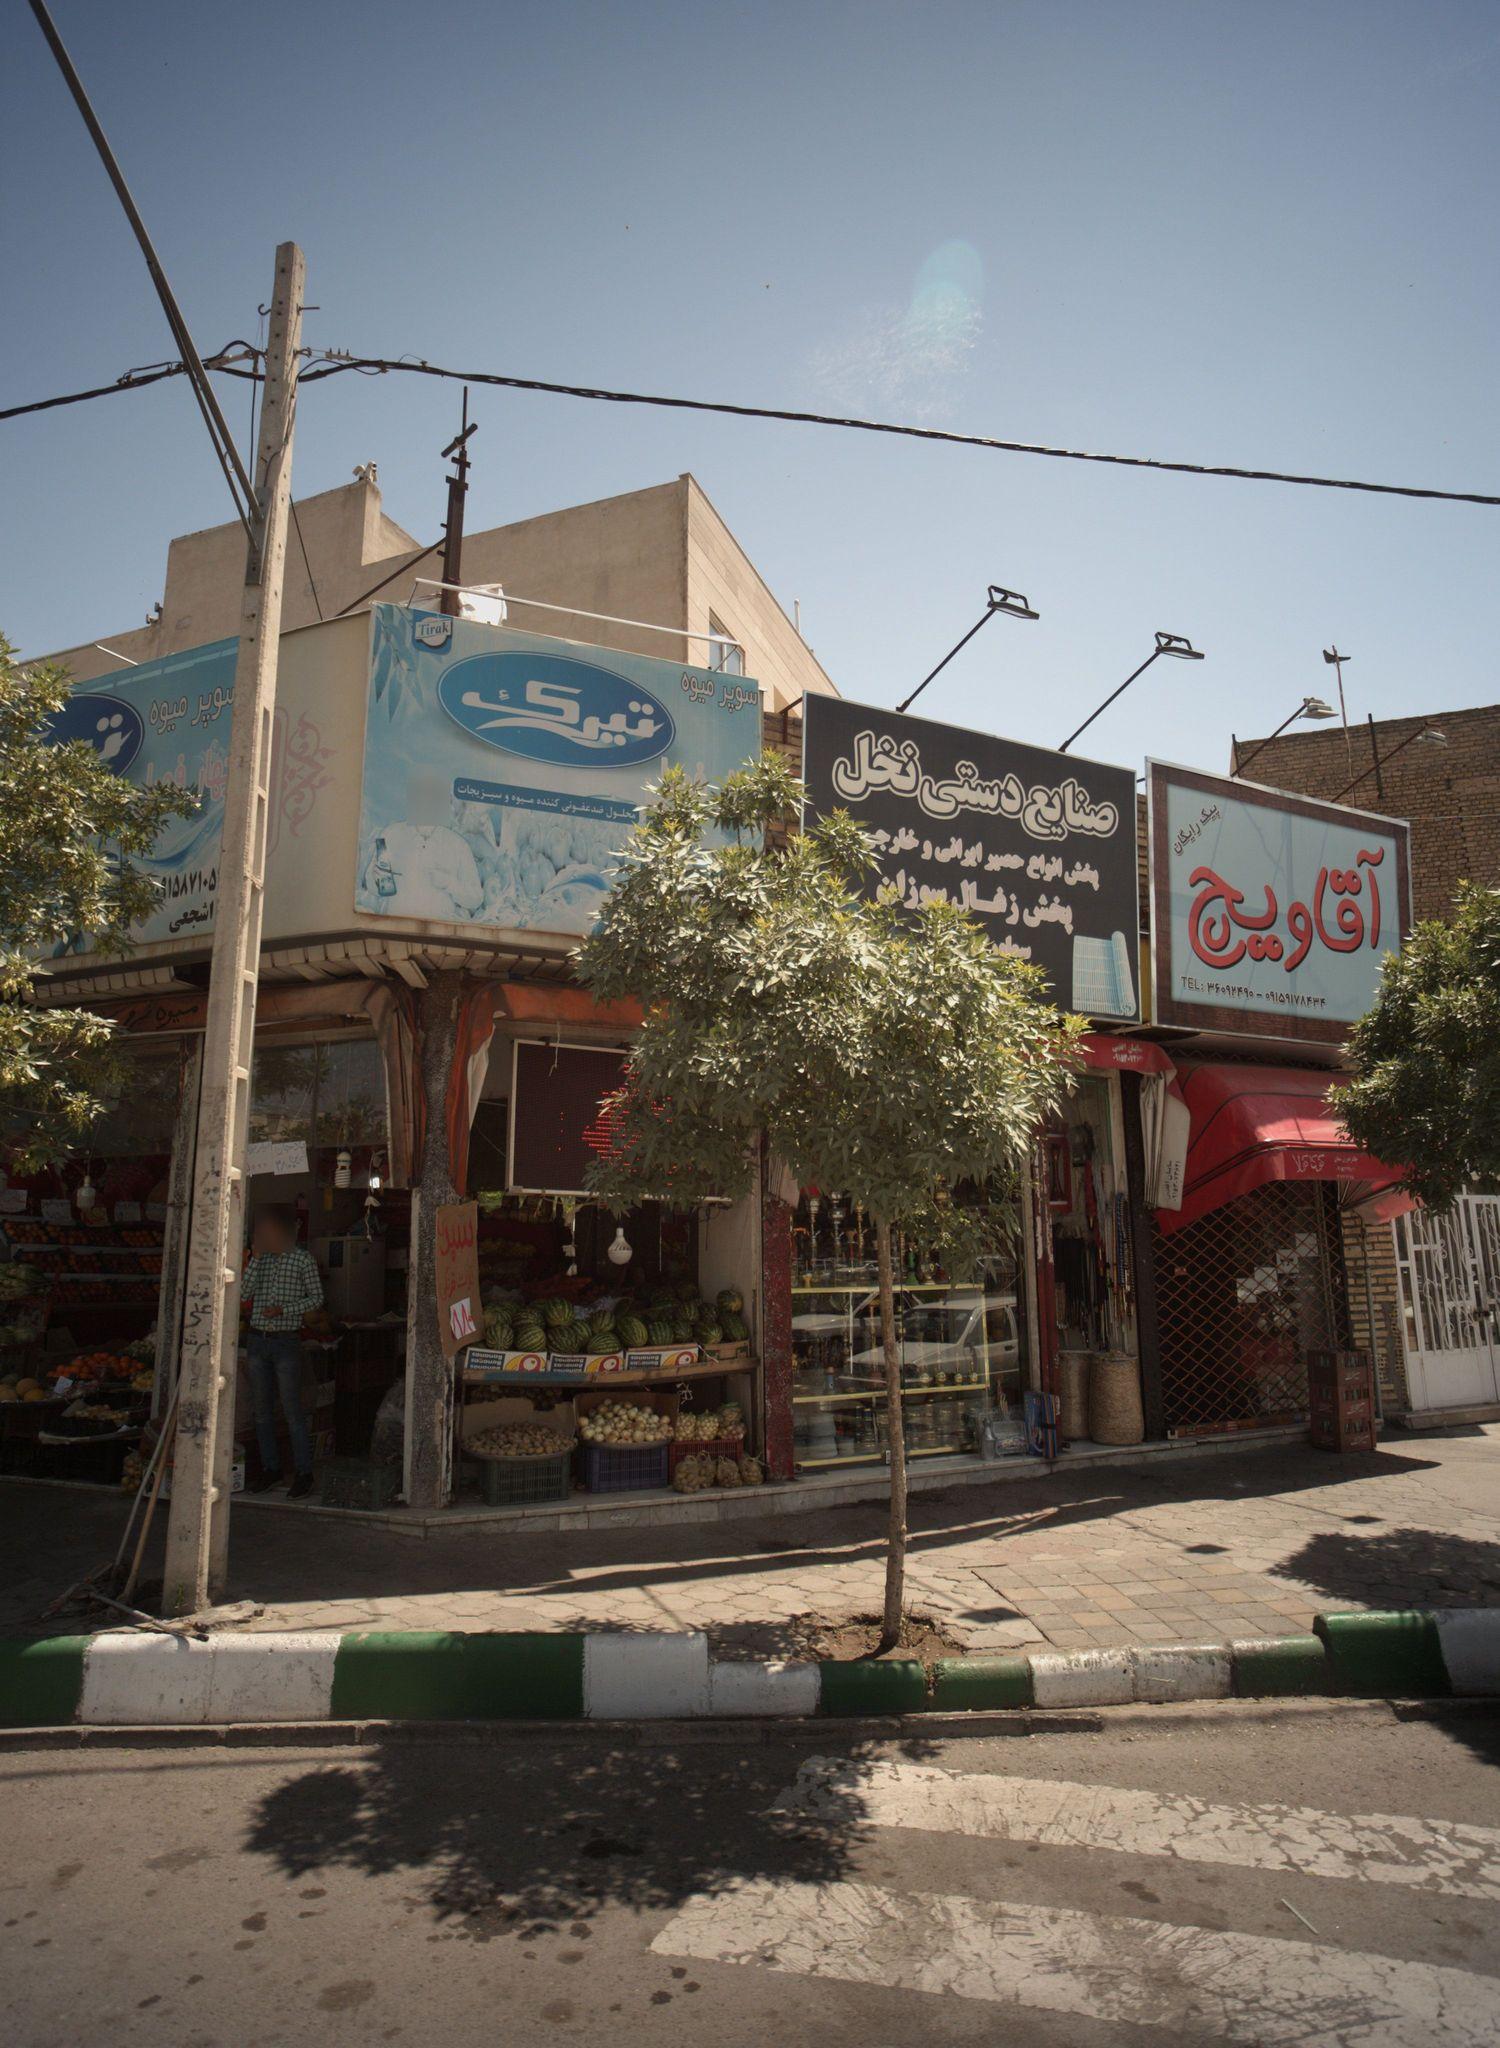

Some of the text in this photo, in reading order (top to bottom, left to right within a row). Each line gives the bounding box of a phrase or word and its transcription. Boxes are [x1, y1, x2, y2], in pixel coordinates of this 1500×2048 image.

[418, 621, 449, 636] Tirak
[680, 670, 758, 713] سوپر میوه
[150, 696, 188, 735] میوه
[511, 793, 534, 805] میوه
[833, 730, 1118, 841] صنایع دستی نخل
[536, 797, 561, 808] کننده
[921, 840, 932, 860] و
[934, 837, 983, 867] ایرانی
[1174, 823, 1202, 855] رایگان
[984, 852, 1024, 872] حصیر
[1026, 856, 1062, 882] انواع
[1064, 860, 1100, 891] پخش
[169, 899, 214, 933] اشجعی
[1023, 893, 1074, 934] پخش
[1181, 975, 1205, 993] TEL:
